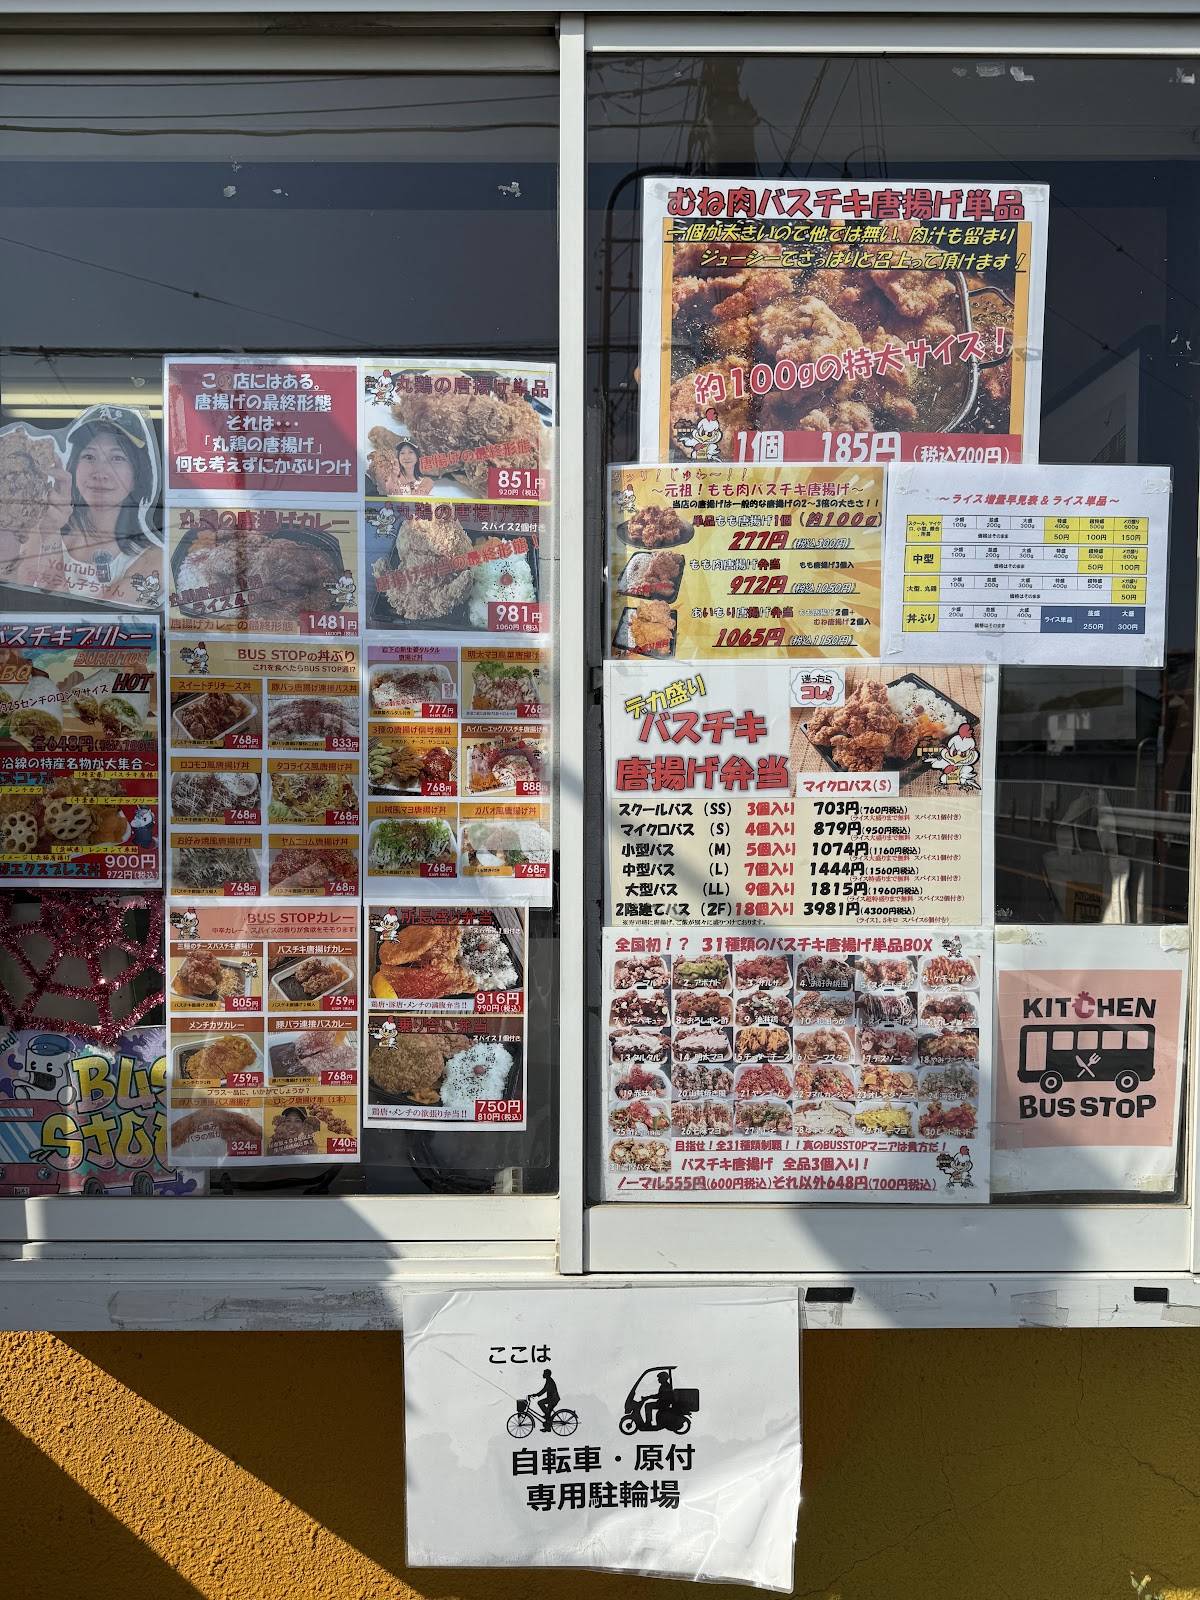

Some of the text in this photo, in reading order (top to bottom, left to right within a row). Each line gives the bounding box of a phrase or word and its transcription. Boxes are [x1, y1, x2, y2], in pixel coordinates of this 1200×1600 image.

[667, 187, 1025, 221] むね肉バスチキ唐揚げ単品
[695, 327, 1005, 405] 約100gの特大サイズ！
[395, 375, 549, 398] 丸鶏の唐揚げ単品
[195, 395, 332, 411] 唐揚げの最終形態
[205, 435, 322, 454] 「丸鶏の唐揚げ」
[737, 431, 784, 463] 1個
[821, 432, 901, 463] 185円
[498, 471, 546, 489] 851円
[728, 530, 790, 549] 277円
[690, 558, 781, 571] もも肉唐揚げ弁当
[913, 554, 934, 564] 中型
[730, 575, 788, 594] 972円
[496, 605, 542, 623] 981円
[691, 606, 794, 618] あいもり唐揚げ弁当
[907, 614, 936, 624] 丼ぶり
[308, 615, 357, 629] 1481円
[715, 628, 786, 646] 1065円
[74, 651, 149, 666] BURRITOS
[238, 649, 355, 662] BUS STOPの丼ぶり
[113, 673, 154, 691] HOT
[801, 673, 833, 685] 迷ったら
[624, 674, 707, 721] デカ盛り
[428, 704, 454, 714] 777円
[639, 710, 768, 745] バスチキ
[232, 735, 259, 745] 768円
[332, 738, 359, 747] 833円
[615, 755, 790, 793] 唐揚げ弁当
[427, 783, 451, 792] 768円
[231, 810, 359, 821] 768円 768円
[619, 803, 694, 816] スクールバス
[747, 802, 795, 815] 3個入り
[620, 823, 695, 836] マイクロバス
[745, 822, 795, 836] 4個入り
[622, 843, 675, 857] 小型バス
[746, 843, 796, 856] 5個入り
[105, 855, 155, 868] 900円
[427, 863, 452, 873] 768円
[521, 865, 546, 874] 768円
[623, 863, 676, 877] 中型バス
[744, 863, 794, 876] 7個入り
[231, 883, 356, 892] 768円 768円
[625, 883, 678, 896] 大型バス
[745, 883, 795, 896] 9個入り
[401, 908, 494, 924] 所長盛り弁当
[616, 903, 691, 916] 2階建てバス
[735, 902, 794, 916] 18個入り
[247, 911, 354, 923] BUS STOPカレー
[277, 945, 352, 953] バスチキ唐揚げカレー
[702, 936, 932, 953] 31種類のバスチキ唐揚げ単品BOX
[232, 996, 355, 1007] 805円 759円
[476, 993, 519, 1004] 916円
[1023, 991, 1156, 1019] KITCHEN
[398, 1018, 487, 1033] 乗り合い弁当
[233, 1074, 258, 1083] 759円
[327, 1072, 352, 1081] 768円
[477, 1101, 520, 1113] 750円
[1019, 1094, 1157, 1119] BUS STOP
[231, 1139, 356, 1151] 324円 740円
[681, 1156, 773, 1172] バスチキ唐揚げ
[783, 1156, 869, 1172] 全品3個入り！
[488, 1344, 552, 1364] ここは
[511, 1443, 696, 1476] 自転車・原付
[526, 1480, 681, 1512] 専用駐輪場
